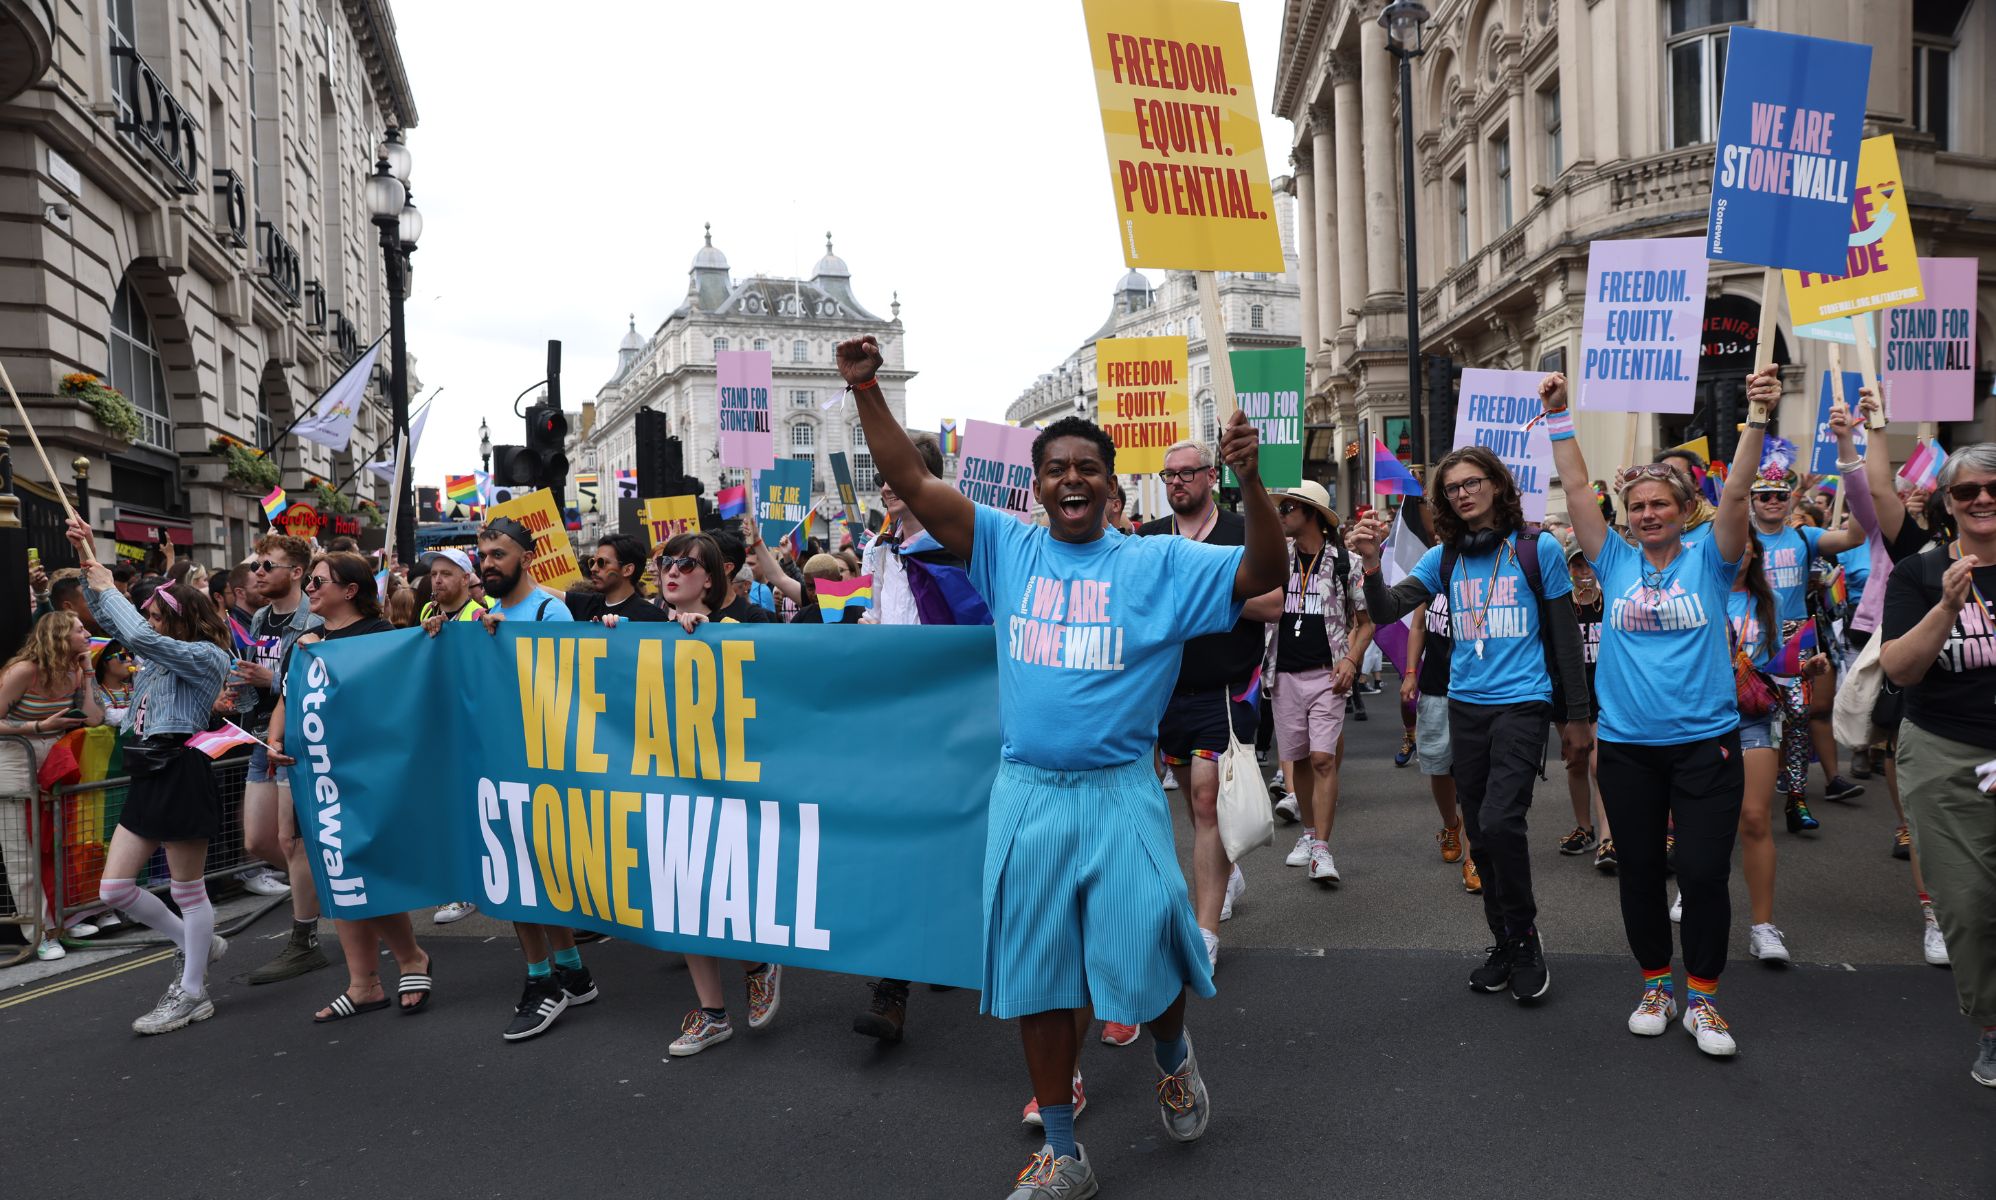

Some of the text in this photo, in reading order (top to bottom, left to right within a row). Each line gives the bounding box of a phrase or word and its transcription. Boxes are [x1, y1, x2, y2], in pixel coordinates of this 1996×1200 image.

[1107, 33, 1237, 96] FREEDOM.
[1134, 98, 1233, 157] EQUITY.
[1751, 102, 1835, 155] WE ARE
[1119, 160, 1267, 220] POTENTIAL.
[1721, 144, 1848, 203] STONEWALL
[1713, 198, 1727, 254] Stonewall
[1599, 270, 1691, 303] FREEDOM.
[1606, 309, 1675, 345] EQUITY.
[1891, 309, 1936, 339] STAND
[1942, 309, 1969, 339] FOR
[1107, 360, 1178, 388] FREEDOM.
[1585, 348, 1690, 381] POTENTIAL.
[1887, 341, 1971, 371] STONEWALL
[721, 387, 768, 410] STAND FOR
[1117, 391, 1170, 420] EQUITY.
[1237, 391, 1298, 418] TAND FOR
[720, 410, 770, 433] STONEWALL
[963, 456, 1032, 489] STAND FOR
[769, 484, 783, 503] WE
[784, 486, 800, 505] ARE
[1021, 575, 1036, 615] Stonewall
[1031, 576, 1111, 623] WE ARE
[1460, 578, 1483, 609] WE
[1610, 593, 1708, 632] STONEWALL
[1009, 615, 1125, 671] STONEWALL
[515, 637, 761, 782] WE ARE
[302, 656, 368, 907] Stonewall
[478, 777, 831, 951] STONEWALL
